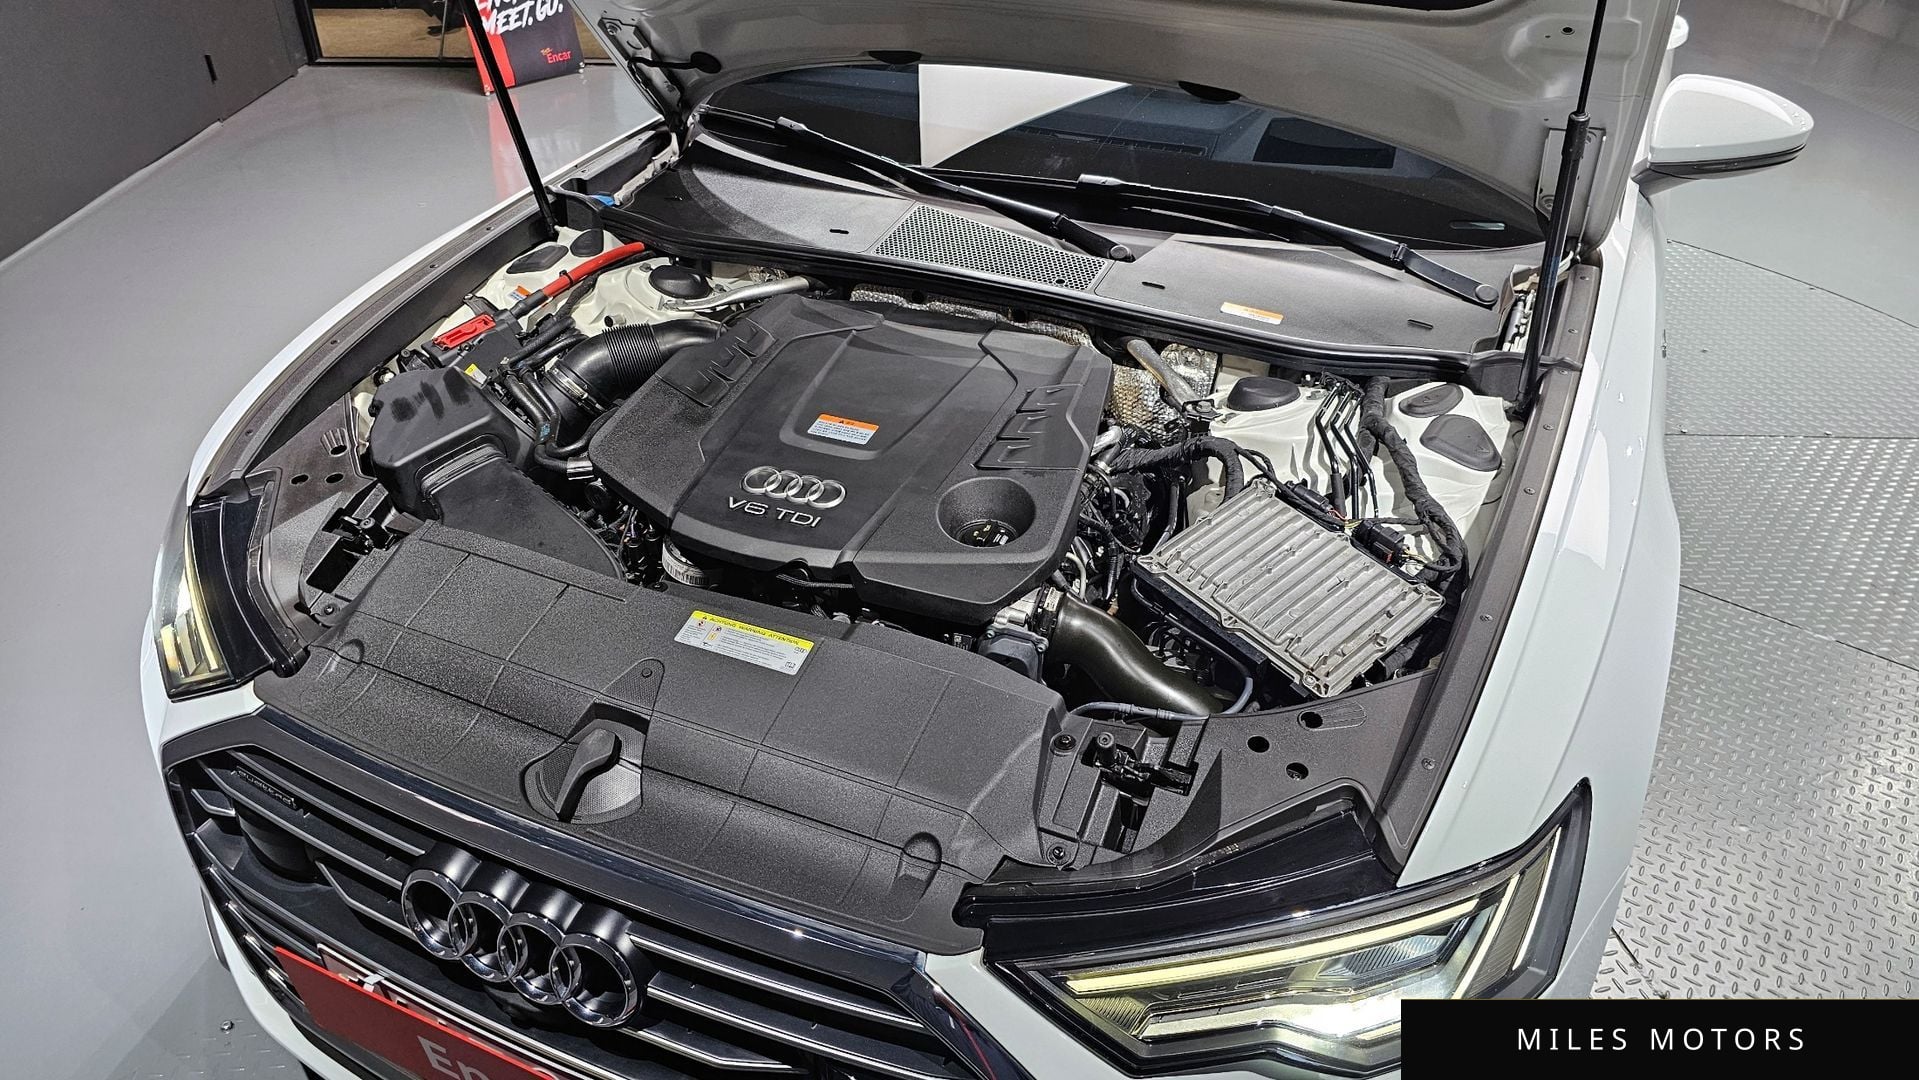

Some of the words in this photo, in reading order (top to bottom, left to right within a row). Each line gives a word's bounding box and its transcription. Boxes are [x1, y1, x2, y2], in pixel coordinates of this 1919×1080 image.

[547, 50, 572, 63] Encar
[729, 496, 769, 515] V6
[776, 507, 822, 528] TDI
